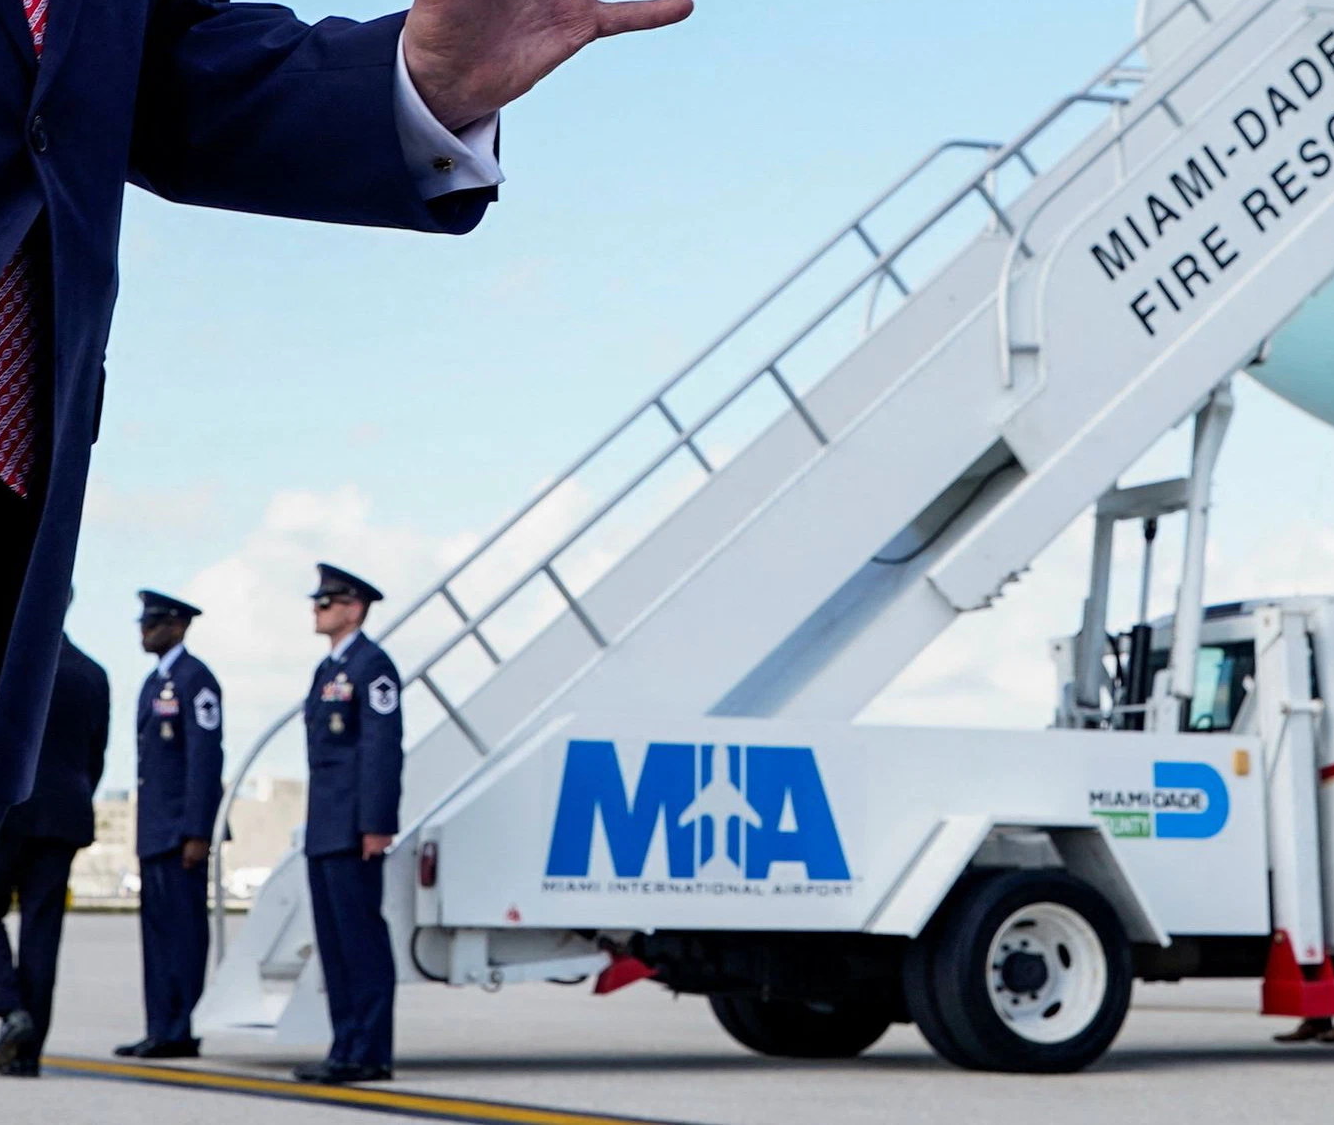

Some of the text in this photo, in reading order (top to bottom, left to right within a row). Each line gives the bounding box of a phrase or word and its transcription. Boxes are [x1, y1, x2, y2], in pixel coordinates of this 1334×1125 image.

[1129, 225, 1240, 336] FIRE
[545, 739, 852, 880] MIA
[541, 881, 854, 896] MIAMI INTERNATIONAL AIRPORT
